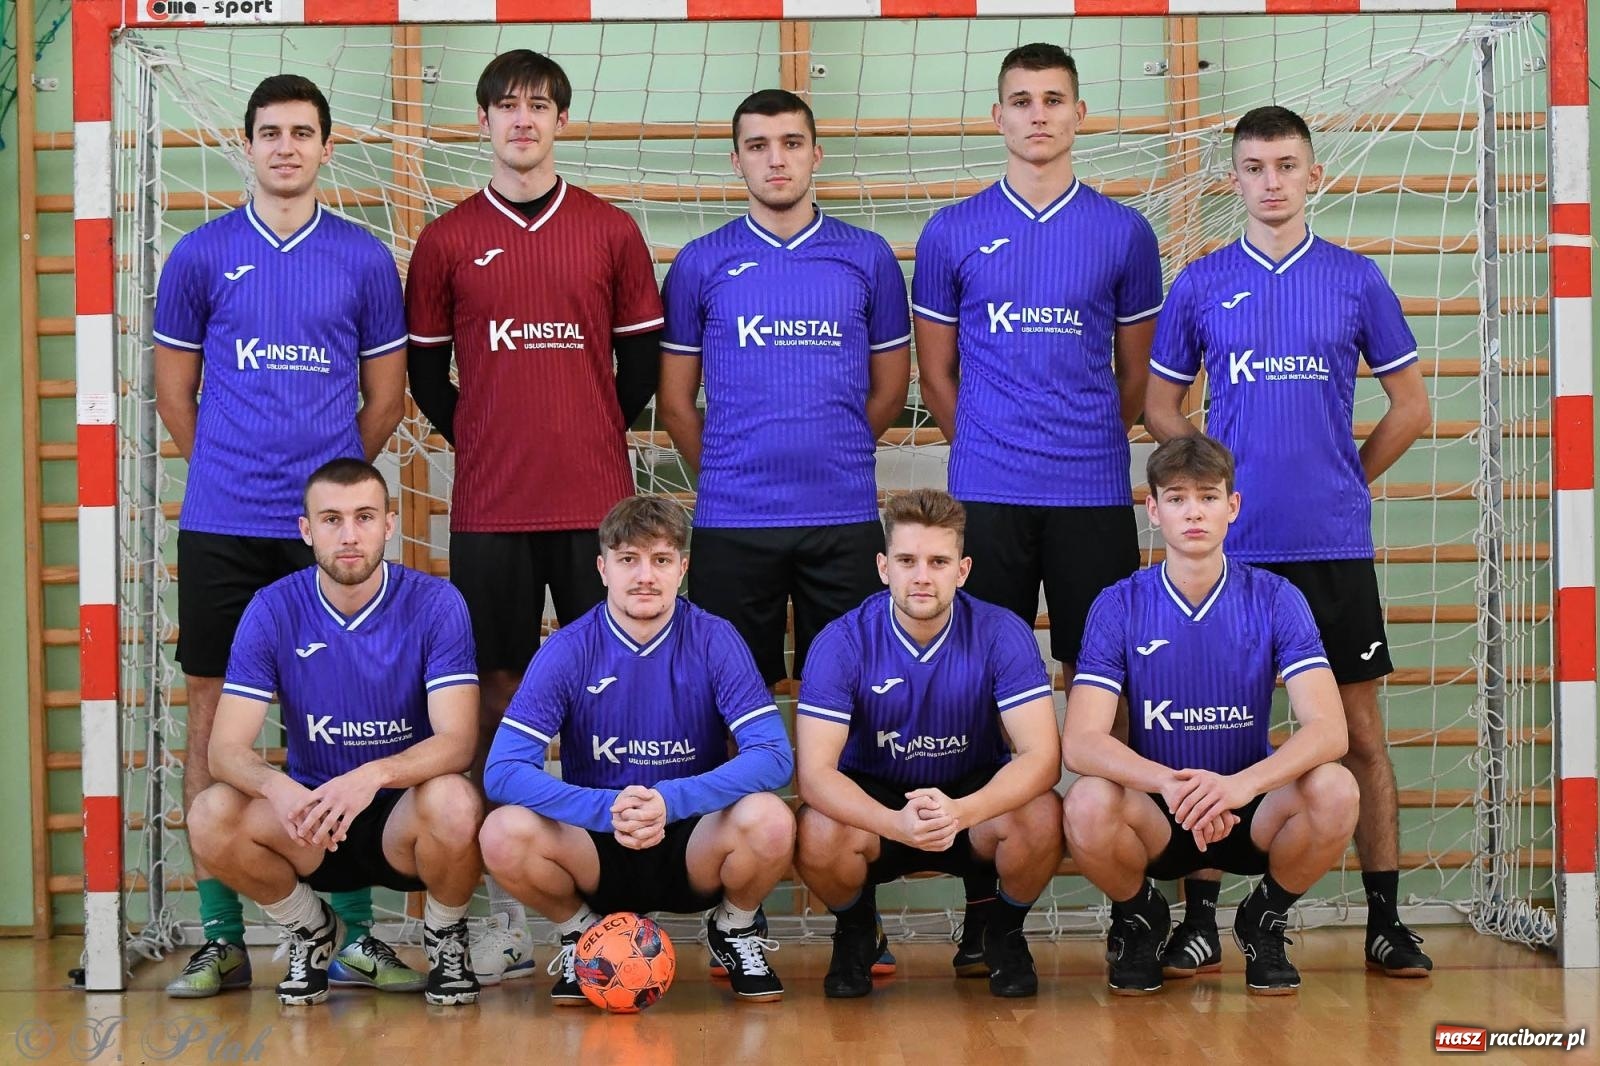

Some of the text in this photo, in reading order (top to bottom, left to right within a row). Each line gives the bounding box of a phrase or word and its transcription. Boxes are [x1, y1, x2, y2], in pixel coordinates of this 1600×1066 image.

[214, 0, 273, 18] sport
[737, 314, 843, 347] K-INSTAL
[987, 301, 1083, 333] K-INSTAL
[489, 318, 585, 352] K-INSTAL
[235, 337, 331, 370] K-INSTAL
[1229, 349, 1330, 385] K-INSTAL
[306, 713, 413, 745] K-INSTAL
[1143, 700, 1254, 731] K-INSTAL
[592, 734, 696, 764] K-INSTAL
[583, 916, 629, 953] SELECT
